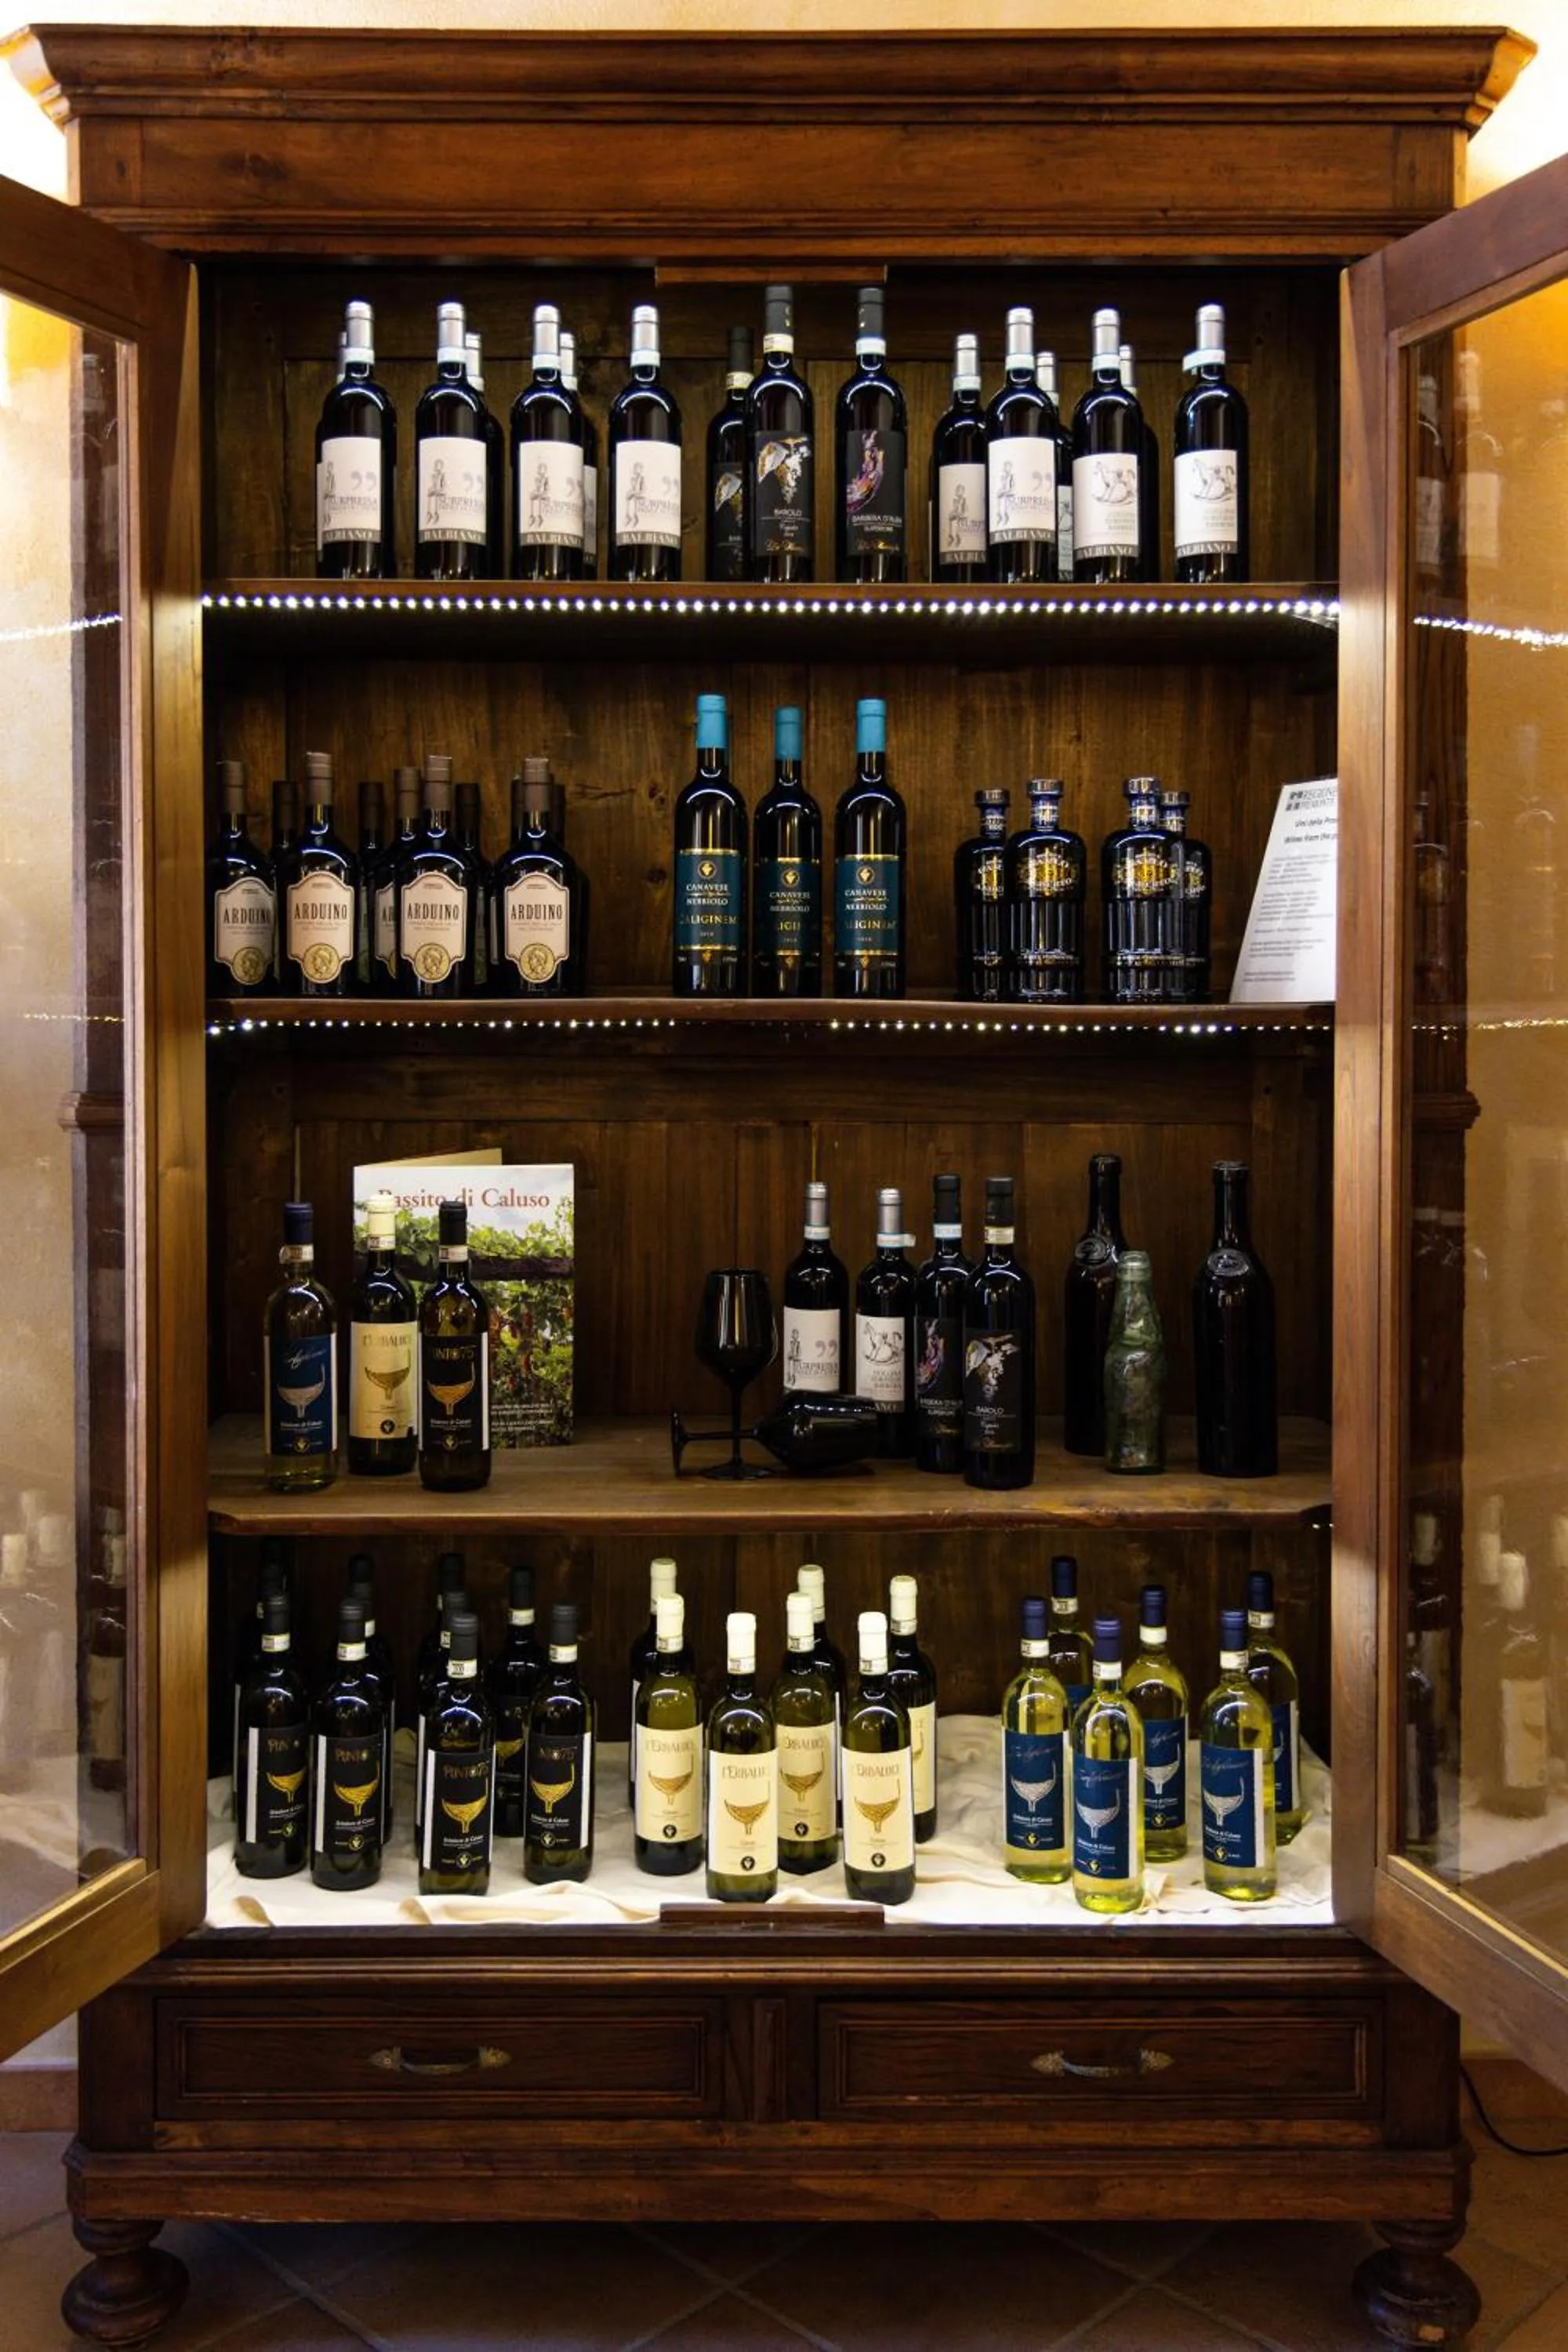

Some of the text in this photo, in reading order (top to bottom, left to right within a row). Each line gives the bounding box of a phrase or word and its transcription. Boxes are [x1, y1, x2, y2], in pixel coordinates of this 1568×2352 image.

[424, 530, 482, 542] BALBIANO
[622, 532, 679, 545] BALBIANO
[994, 529, 1052, 542] BALBIANO
[294, 902, 348, 920] ARDUINO
[407, 902, 459, 920] ARDUINO
[510, 903, 563, 920] ARDUINO
[455, 1188, 473, 1207] di
[481, 1188, 550, 1208] Caluso
